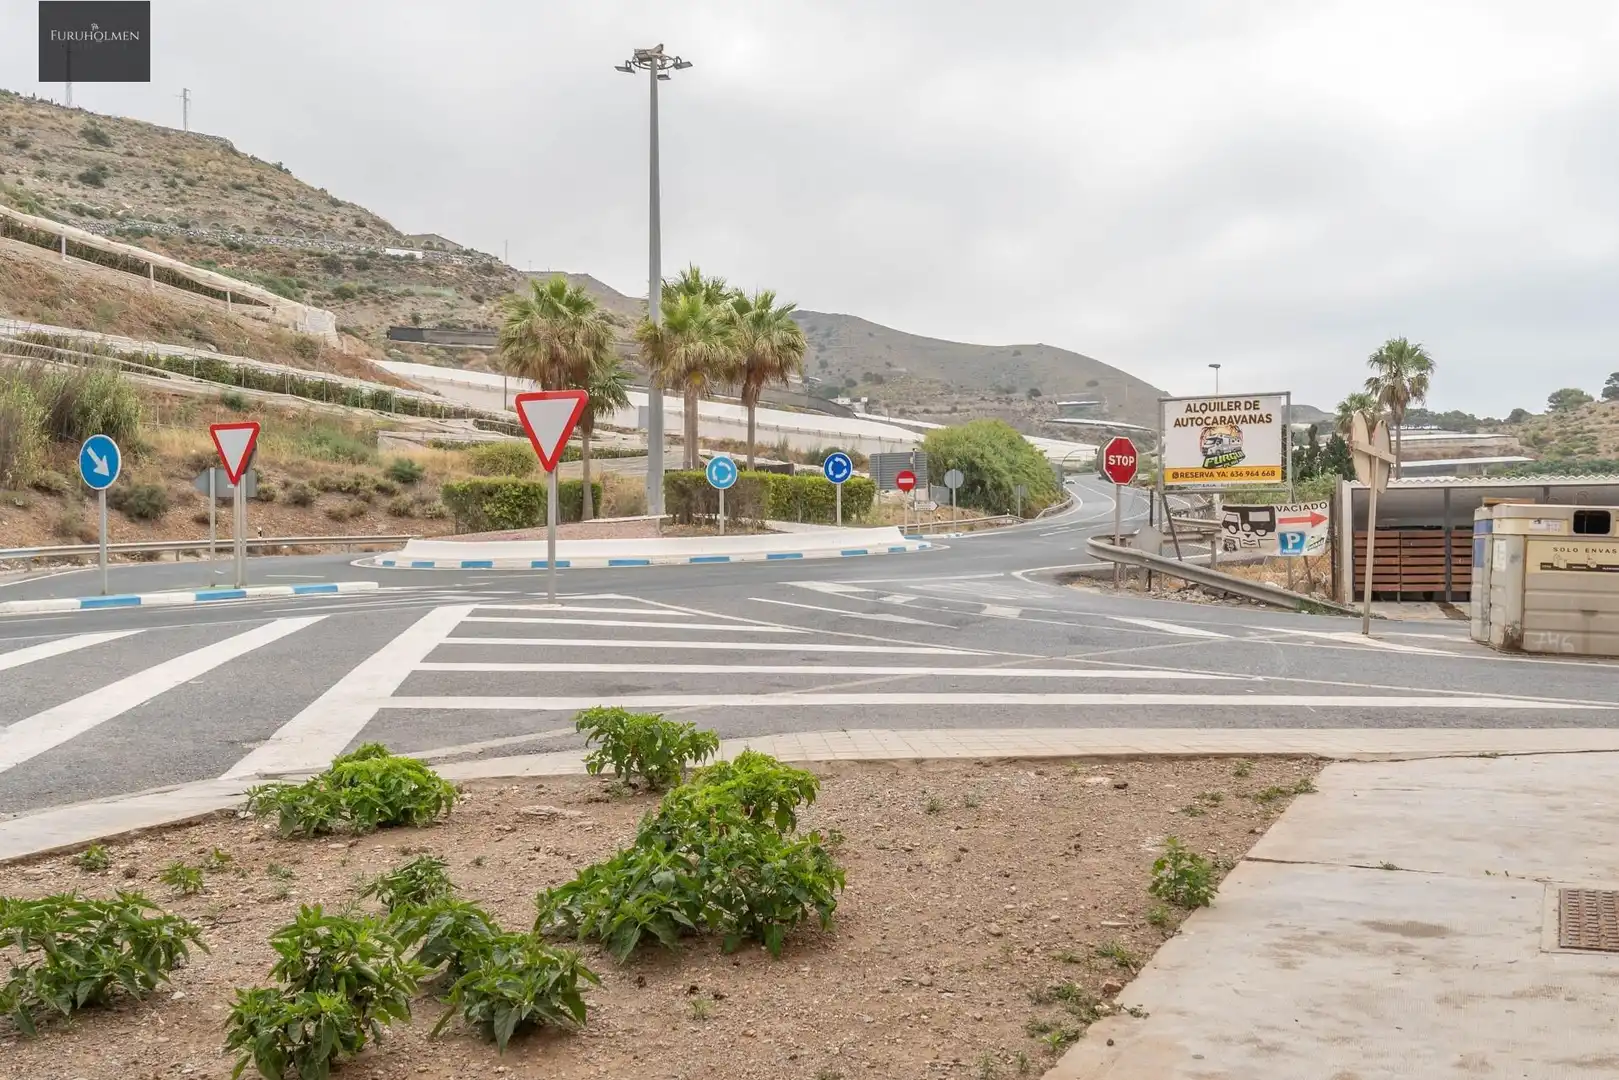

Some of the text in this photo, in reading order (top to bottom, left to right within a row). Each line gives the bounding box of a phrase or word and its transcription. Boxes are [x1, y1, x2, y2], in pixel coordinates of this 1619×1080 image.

[1185, 400, 1260, 413] ALQUILER DE
[1173, 413, 1273, 428] AUTOCARAVANAS
[1108, 454, 1135, 467] STOP
[1276, 501, 1328, 512] VACIADO
[1287, 532, 1300, 549] P
